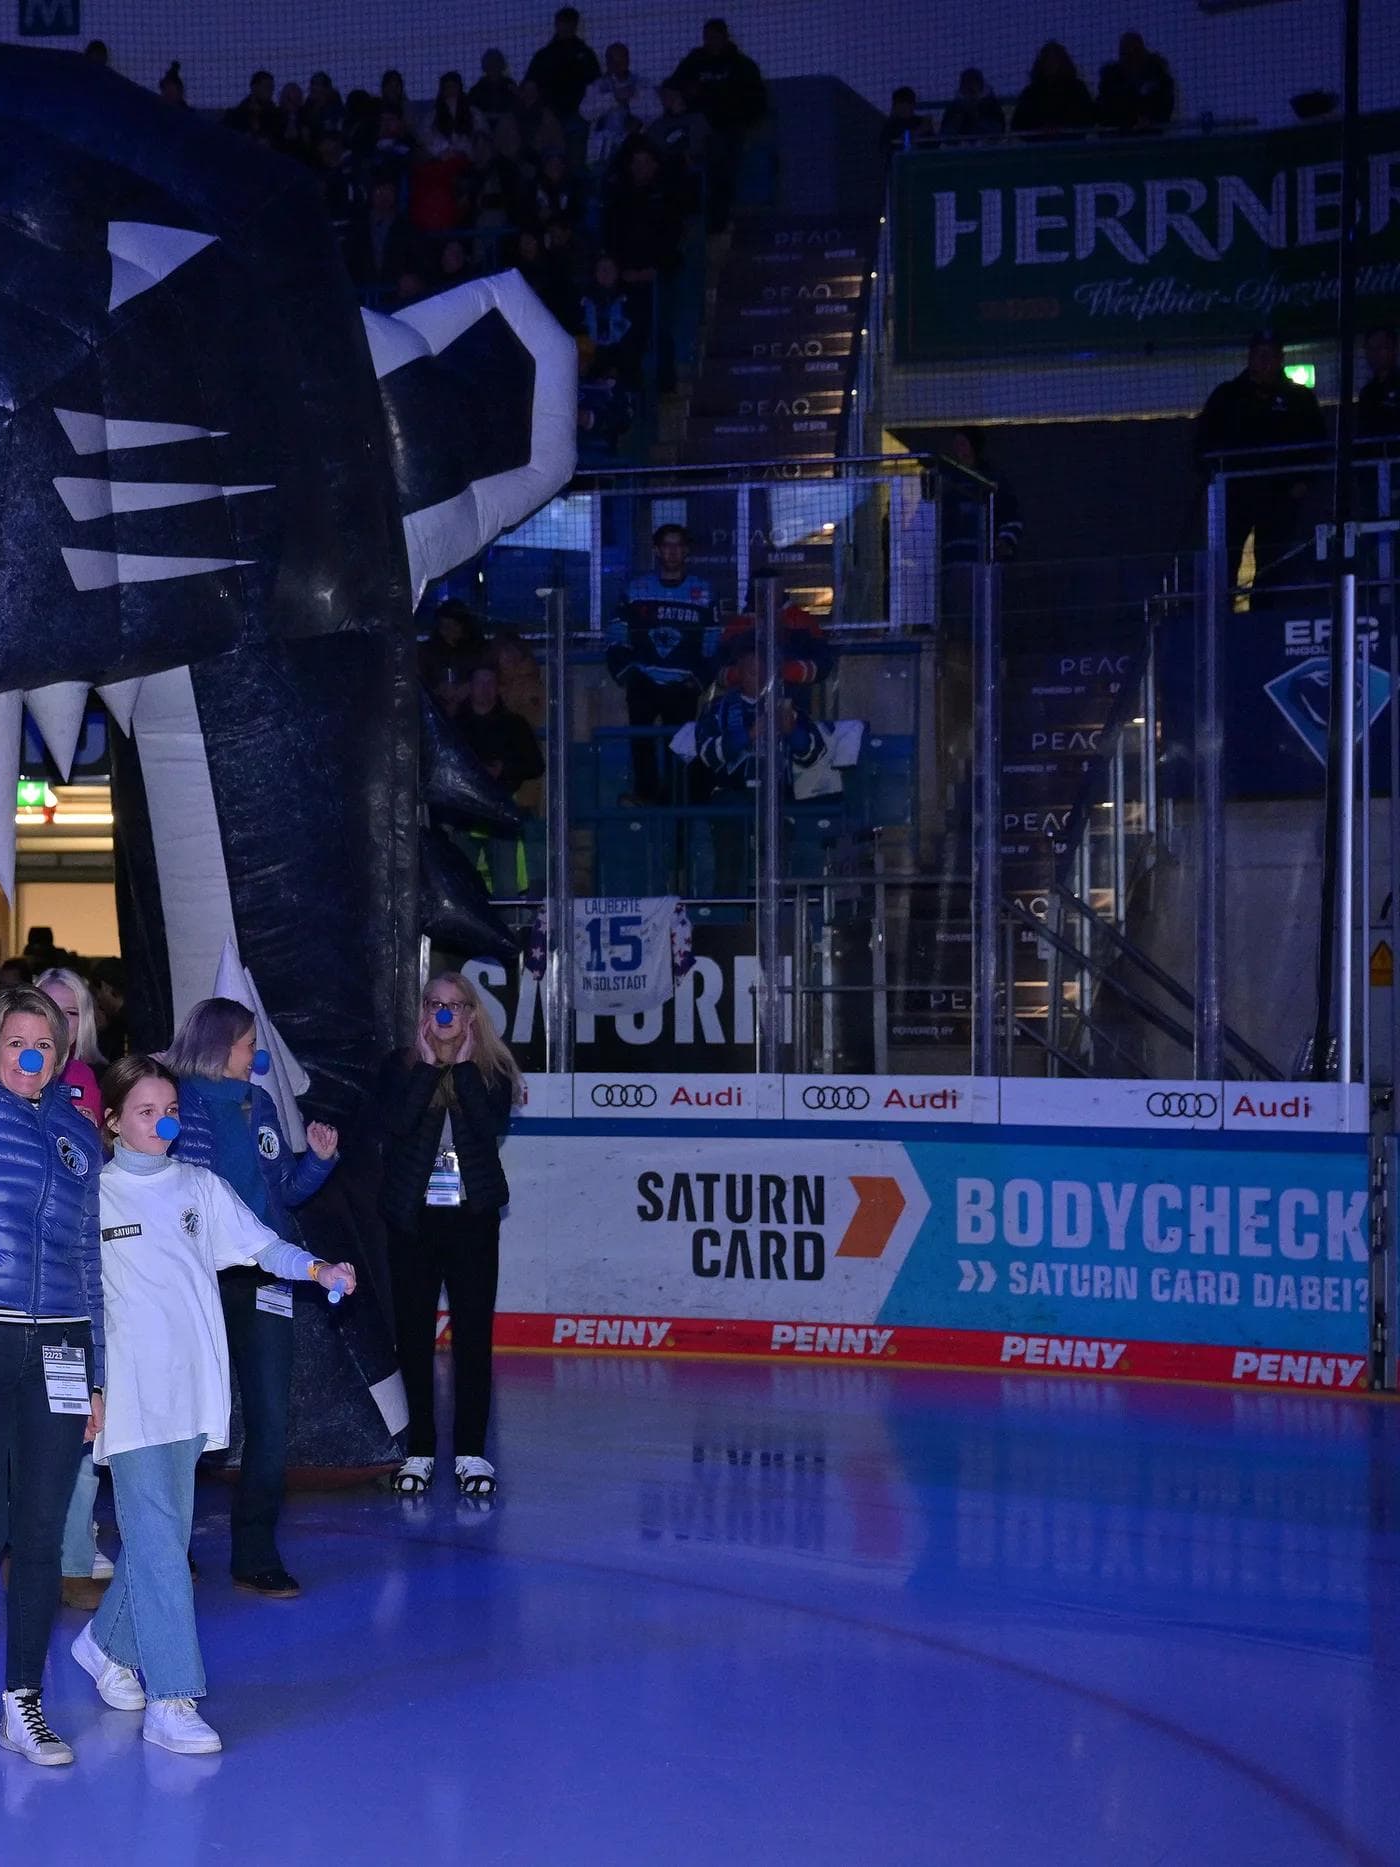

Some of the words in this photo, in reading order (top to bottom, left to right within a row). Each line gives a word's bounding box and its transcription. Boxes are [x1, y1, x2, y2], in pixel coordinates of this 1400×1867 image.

[585, 916, 642, 972] 15
[582, 974, 648, 991] INGOLSTADT
[671, 1085, 743, 1107] Audi
[884, 1087, 958, 1109] Audi
[1233, 1094, 1311, 1118] Audi
[637, 1171, 825, 1226] SATURN
[956, 1176, 1369, 1263] BODYCHECK
[113, 1225, 140, 1239] SATURN
[692, 1227, 825, 1282] CARD
[1008, 1261, 1139, 1300] SATURN
[1150, 1266, 1240, 1307] CARD
[1253, 1273, 1369, 1314] DABEI?
[44, 1351, 63, 1360] 22/23
